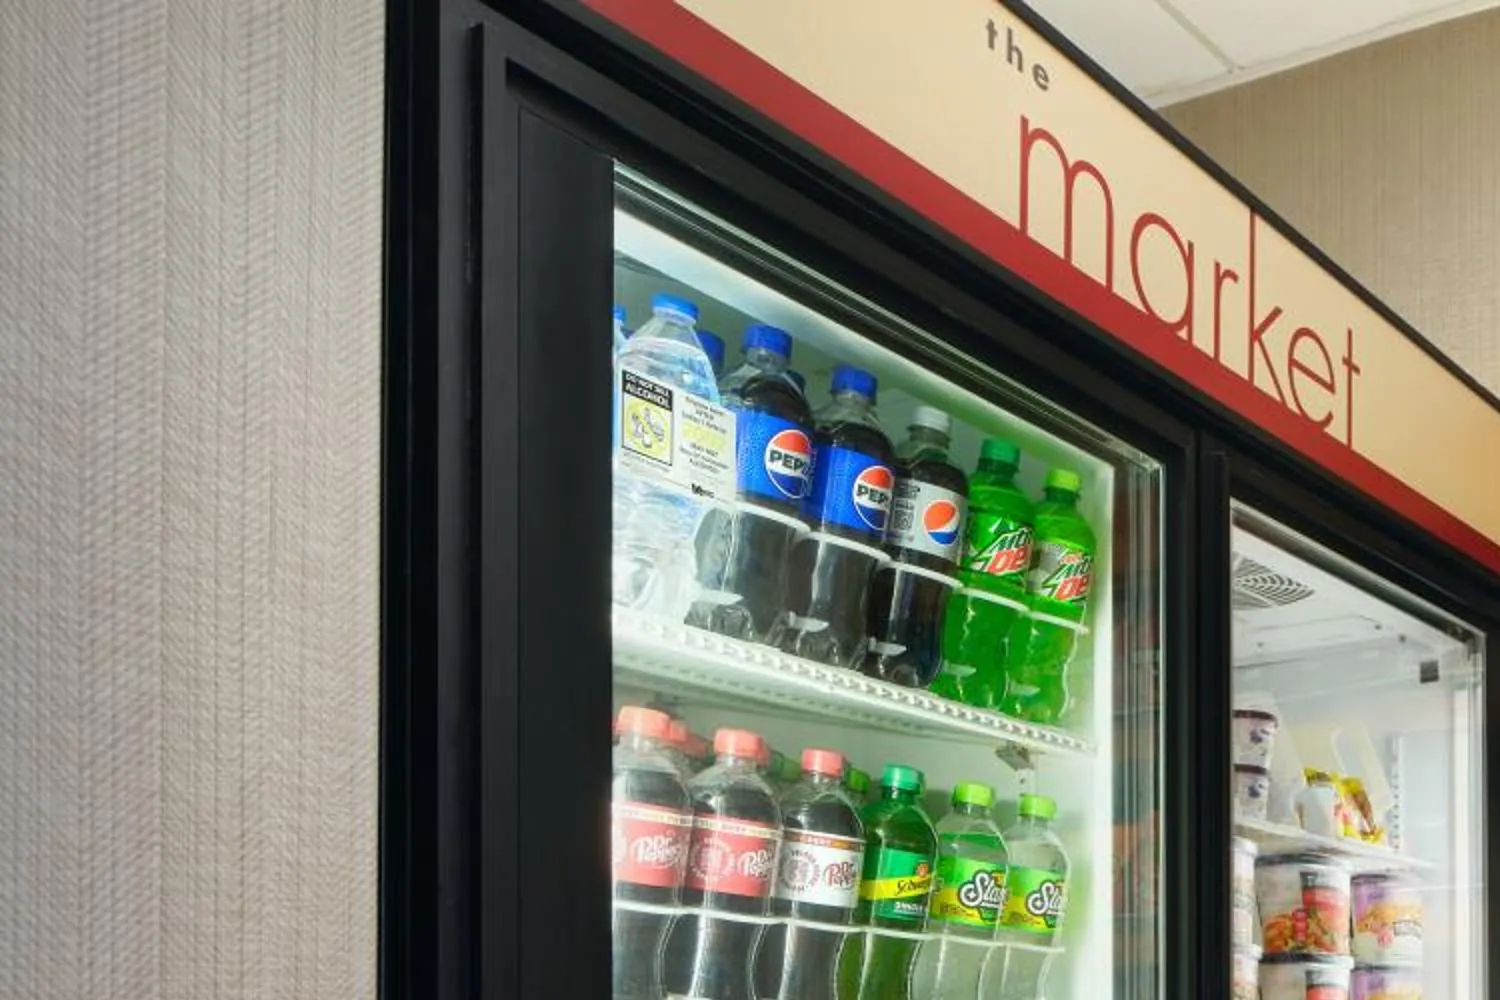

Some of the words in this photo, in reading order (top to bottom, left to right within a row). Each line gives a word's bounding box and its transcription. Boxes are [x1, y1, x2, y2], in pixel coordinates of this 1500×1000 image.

[985, 18, 1050, 91] the
[1019, 114, 1361, 449] market
[856, 483, 891, 505] PEP
[986, 544, 1030, 575] DE
